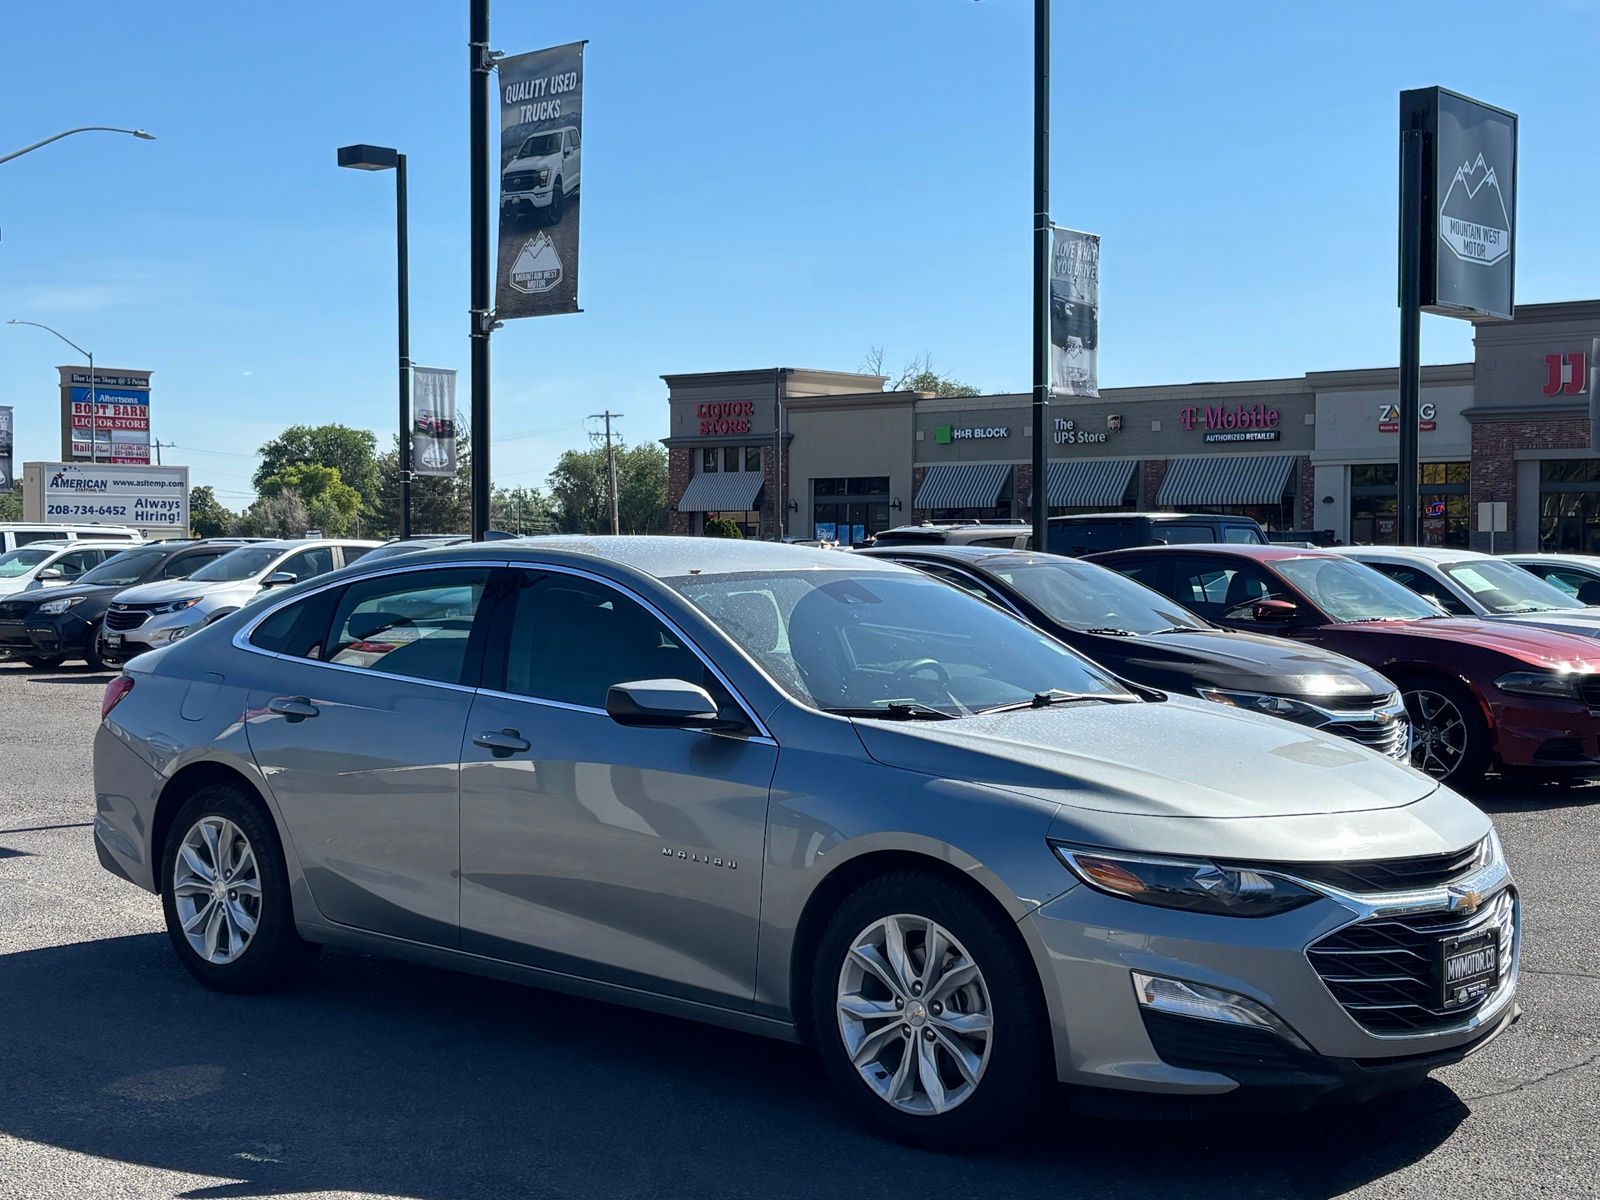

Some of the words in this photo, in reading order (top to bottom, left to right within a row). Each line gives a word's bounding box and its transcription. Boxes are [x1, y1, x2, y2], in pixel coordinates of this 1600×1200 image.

[505, 77, 548, 105] QUALITY
[550, 71, 577, 95] USED
[520, 99, 560, 124] TRUCKS
[1450, 218, 1481, 240] MOUNTAIN
[1482, 227, 1501, 245] WEST
[1056, 240, 1076, 258] LOVE
[1463, 239, 1486, 258] MOTOR
[1056, 259, 1073, 274] YOU
[1074, 262, 1096, 279] DRIVE
[99, 394, 138, 404] Albertsons
[113, 405, 146, 417] BARN
[696, 401, 753, 420] LIQUOR
[1178, 403, 1279, 431] T-Mobile
[114, 419, 147, 429] STORE
[700, 418, 750, 435] STORE
[1054, 418, 1074, 430] The
[954, 429, 972, 439] H&R
[974, 427, 1008, 438] BLOCK
[1054, 432, 1075, 444] UPS
[1078, 431, 1106, 443] Store
[1206, 433, 1246, 442] AUTHORIZED
[1246, 432, 1275, 441] RETAILER
[50, 476, 108, 489] AMERICAN
[47, 504, 126, 516] 208-734-6452
[134, 498, 180, 512] Always
[135, 510, 180, 524] Hiring!
[817, 529, 835, 540] Enjoy
[662, 847, 738, 870] MALIBU
[1447, 948, 1495, 981] MWMOTOR.CO
